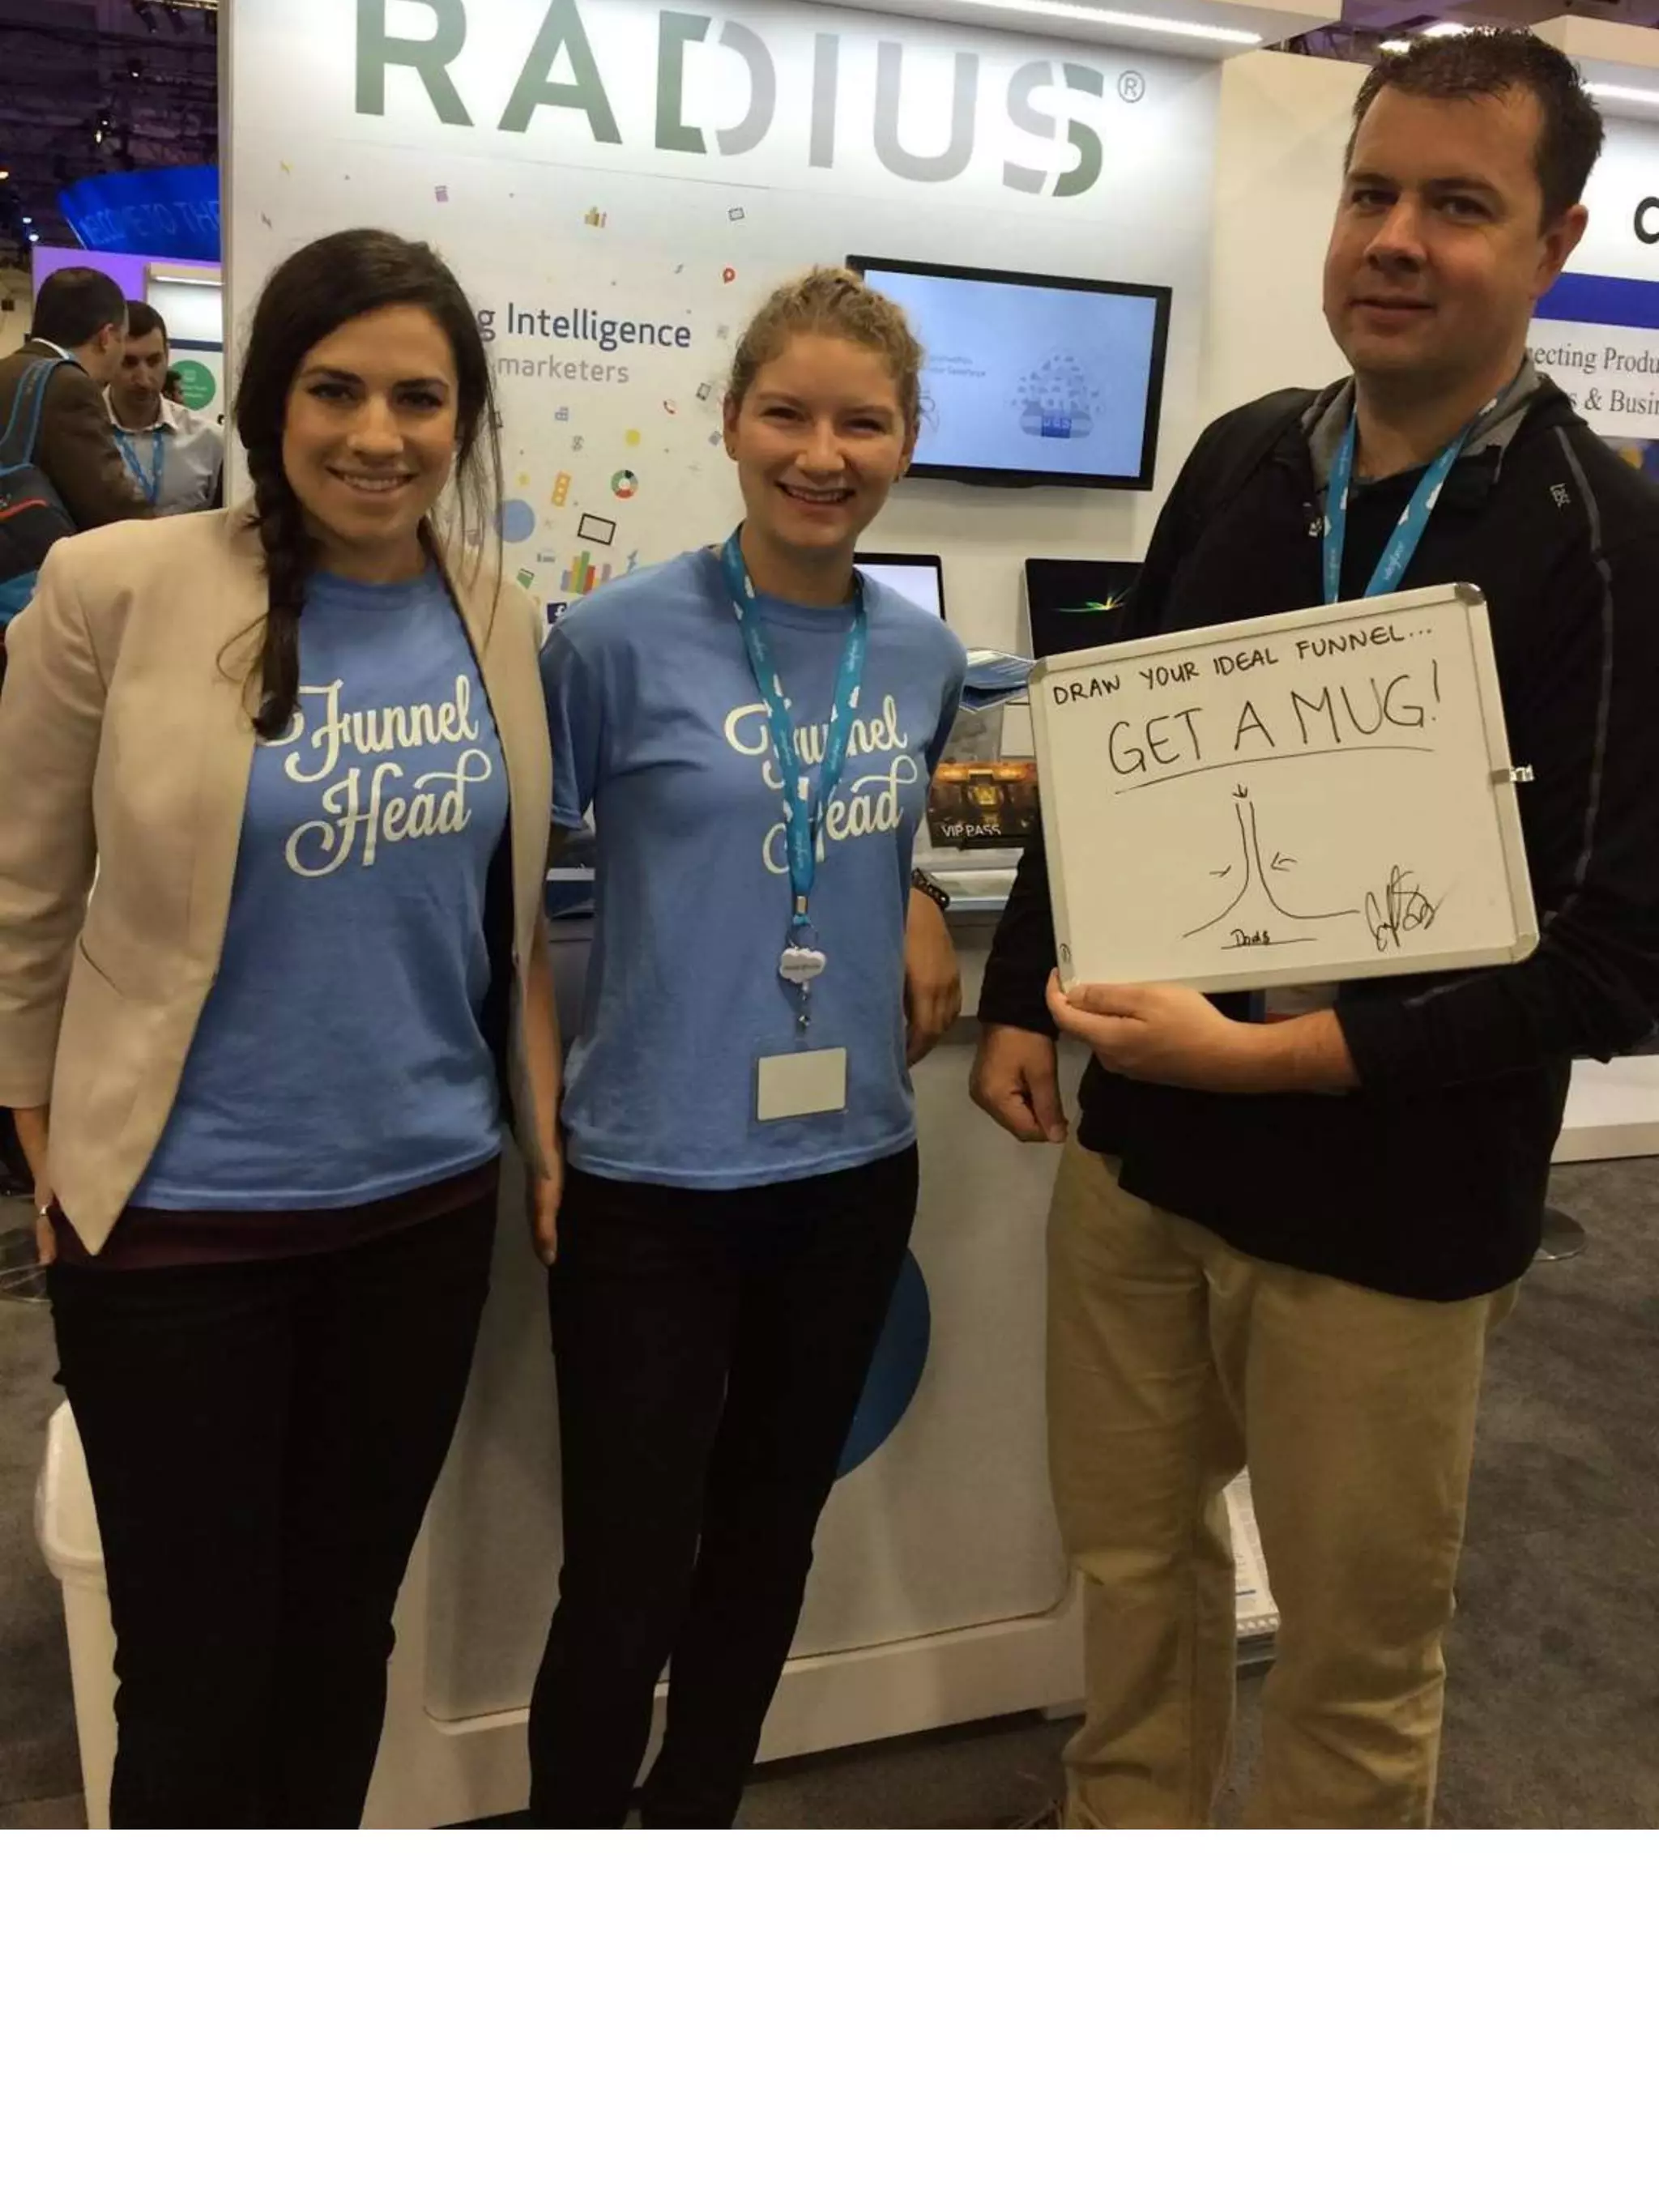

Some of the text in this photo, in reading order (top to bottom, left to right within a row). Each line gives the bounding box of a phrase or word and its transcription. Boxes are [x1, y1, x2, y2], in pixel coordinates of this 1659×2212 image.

[507, 302, 691, 352] Intelligence
[497, 355, 629, 383] marketers
[1584, 387, 1602, 411] &
[1052, 675, 1121, 705] DRAW
[1139, 662, 1200, 689] YOUR
[1213, 648, 1278, 676] IDEAL
[265, 674, 479, 783] Funnel
[1108, 658, 1441, 775] GET A MUG!
[285, 748, 492, 876] Head
[940, 824, 1002, 837] VIP PASS
